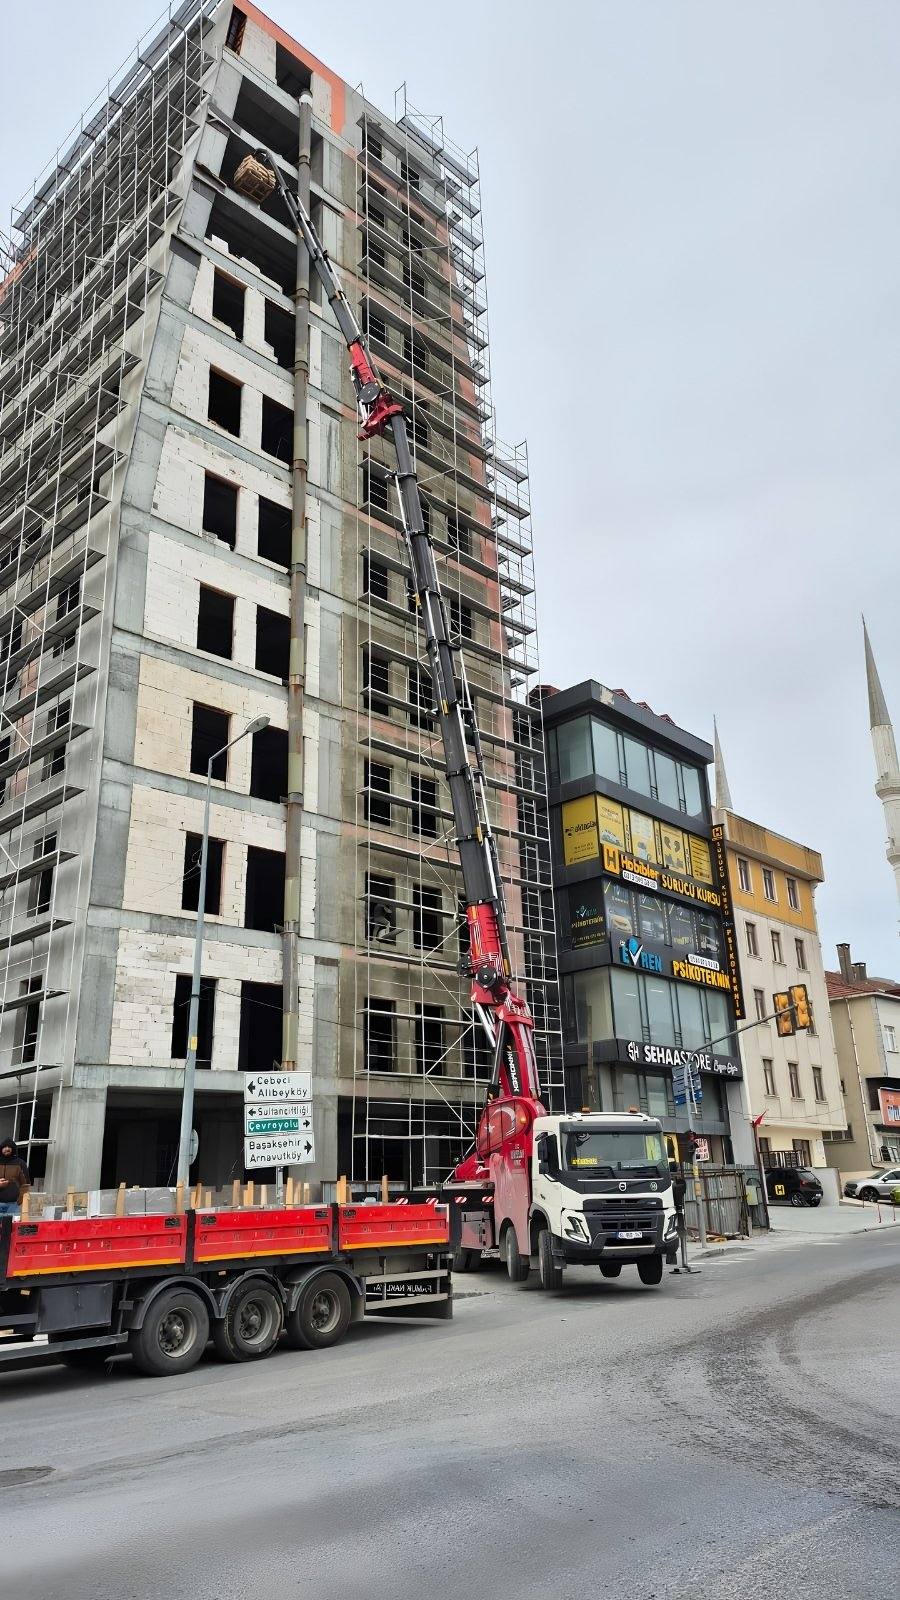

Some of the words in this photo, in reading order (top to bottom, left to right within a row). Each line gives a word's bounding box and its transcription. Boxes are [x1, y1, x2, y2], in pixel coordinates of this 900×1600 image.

[661, 873, 695, 898] SÜRÜCÜ
[696, 886, 721, 907] KURSU
[672, 959, 730, 989] PSİKOTEKNİK
[257, 1077, 290, 1085] Cebeci
[258, 1088, 308, 1098] Alibeyköy
[249, 1120, 298, 1131] Çevreyolu
[249, 1140, 301, 1150] Başakşehir
[250, 1152, 302, 1162] Arnavutköy
